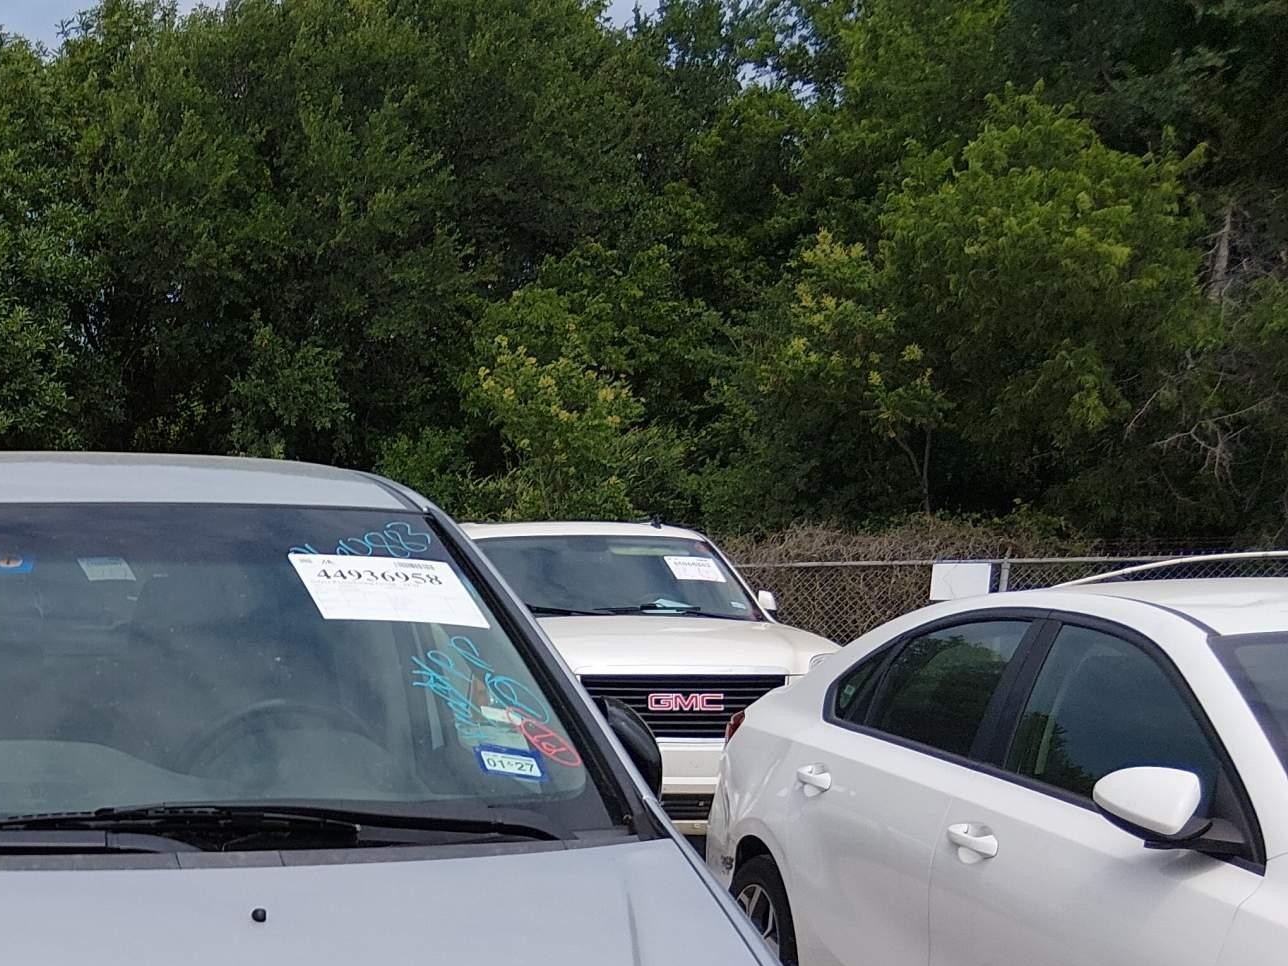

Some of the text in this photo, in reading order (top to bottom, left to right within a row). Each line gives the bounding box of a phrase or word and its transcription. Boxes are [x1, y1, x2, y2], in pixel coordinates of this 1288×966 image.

[316, 568, 444, 586] 44936958
[648, 693, 725, 711] GMC
[486, 757, 535, 774] 01 27
